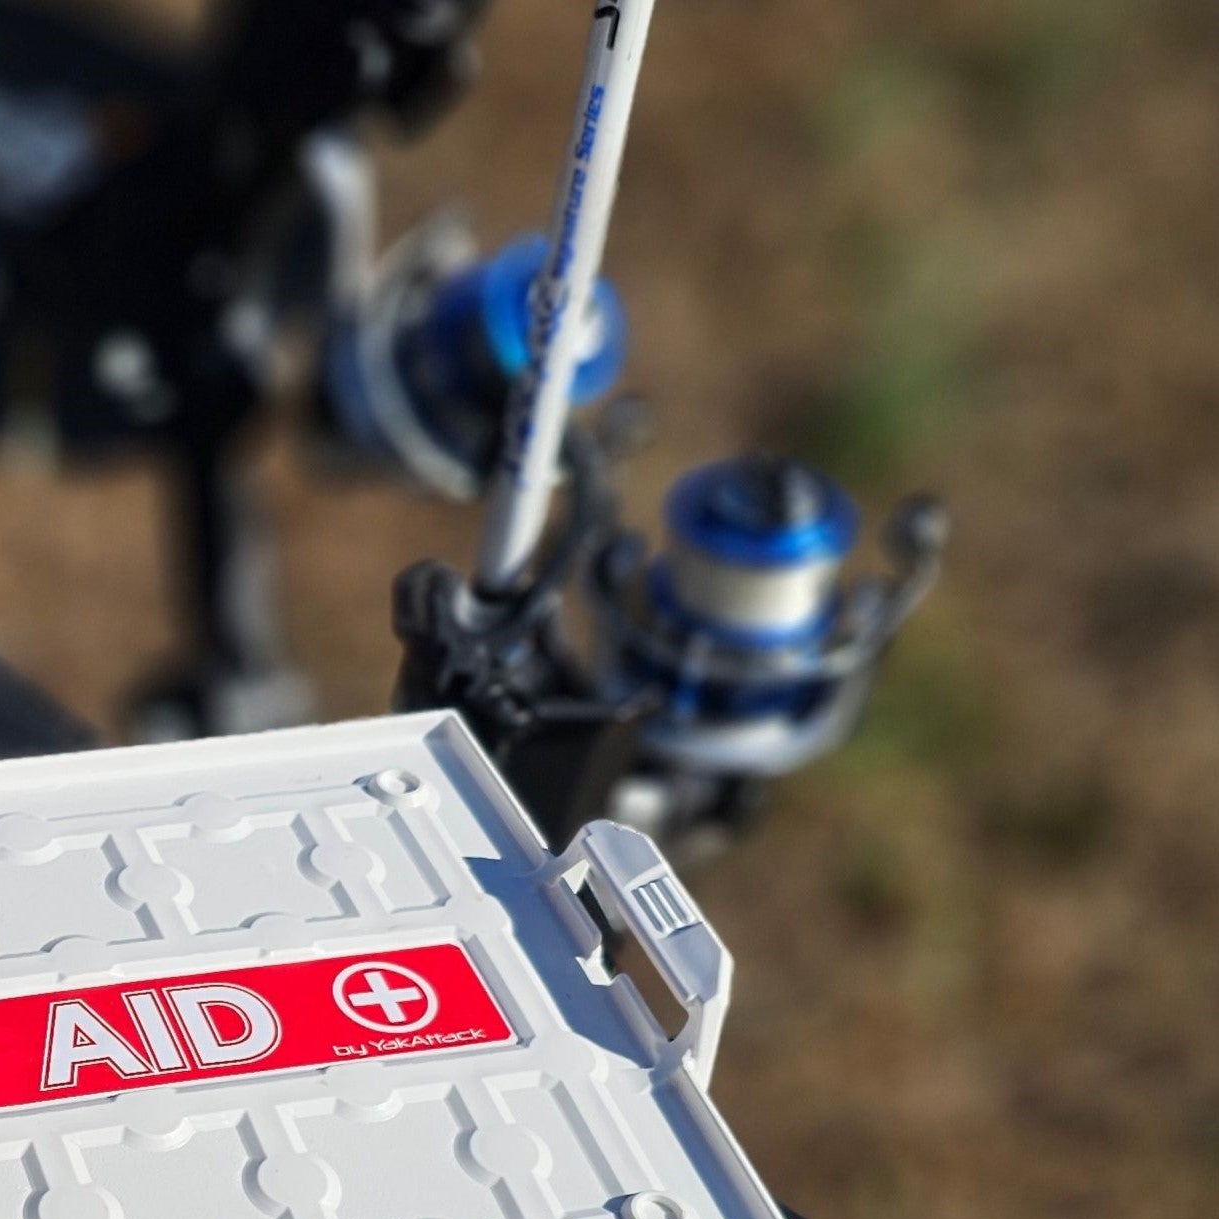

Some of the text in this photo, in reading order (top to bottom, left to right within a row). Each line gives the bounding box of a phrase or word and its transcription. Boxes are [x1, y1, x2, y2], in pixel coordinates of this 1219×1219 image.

[575, 84, 605, 163] Series
[42, 984, 280, 1090] AID
[333, 1028, 486, 1056] by YakAttack
